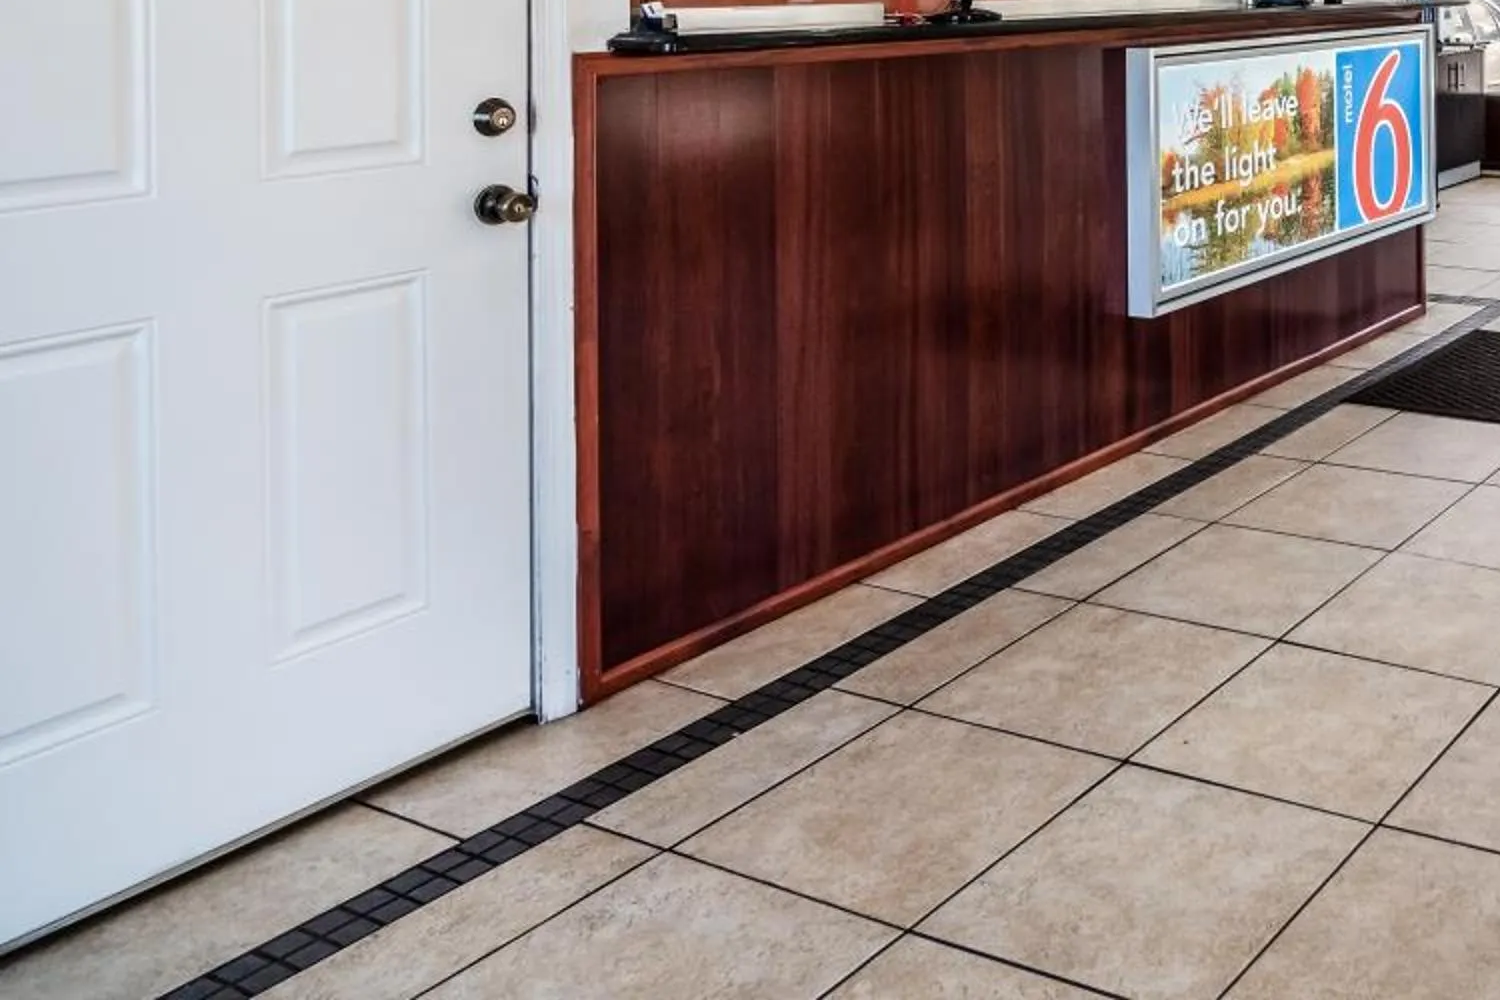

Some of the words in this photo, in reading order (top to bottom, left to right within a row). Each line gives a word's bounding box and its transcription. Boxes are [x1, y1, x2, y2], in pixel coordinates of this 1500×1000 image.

[1241, 91, 1299, 126] leave
[1342, 63, 1353, 123] motel
[1353, 49, 1413, 222] 6
[1172, 152, 1216, 193] the
[1225, 140, 1277, 187] light
[1173, 214, 1206, 246] on
[1215, 199, 1251, 236] for
